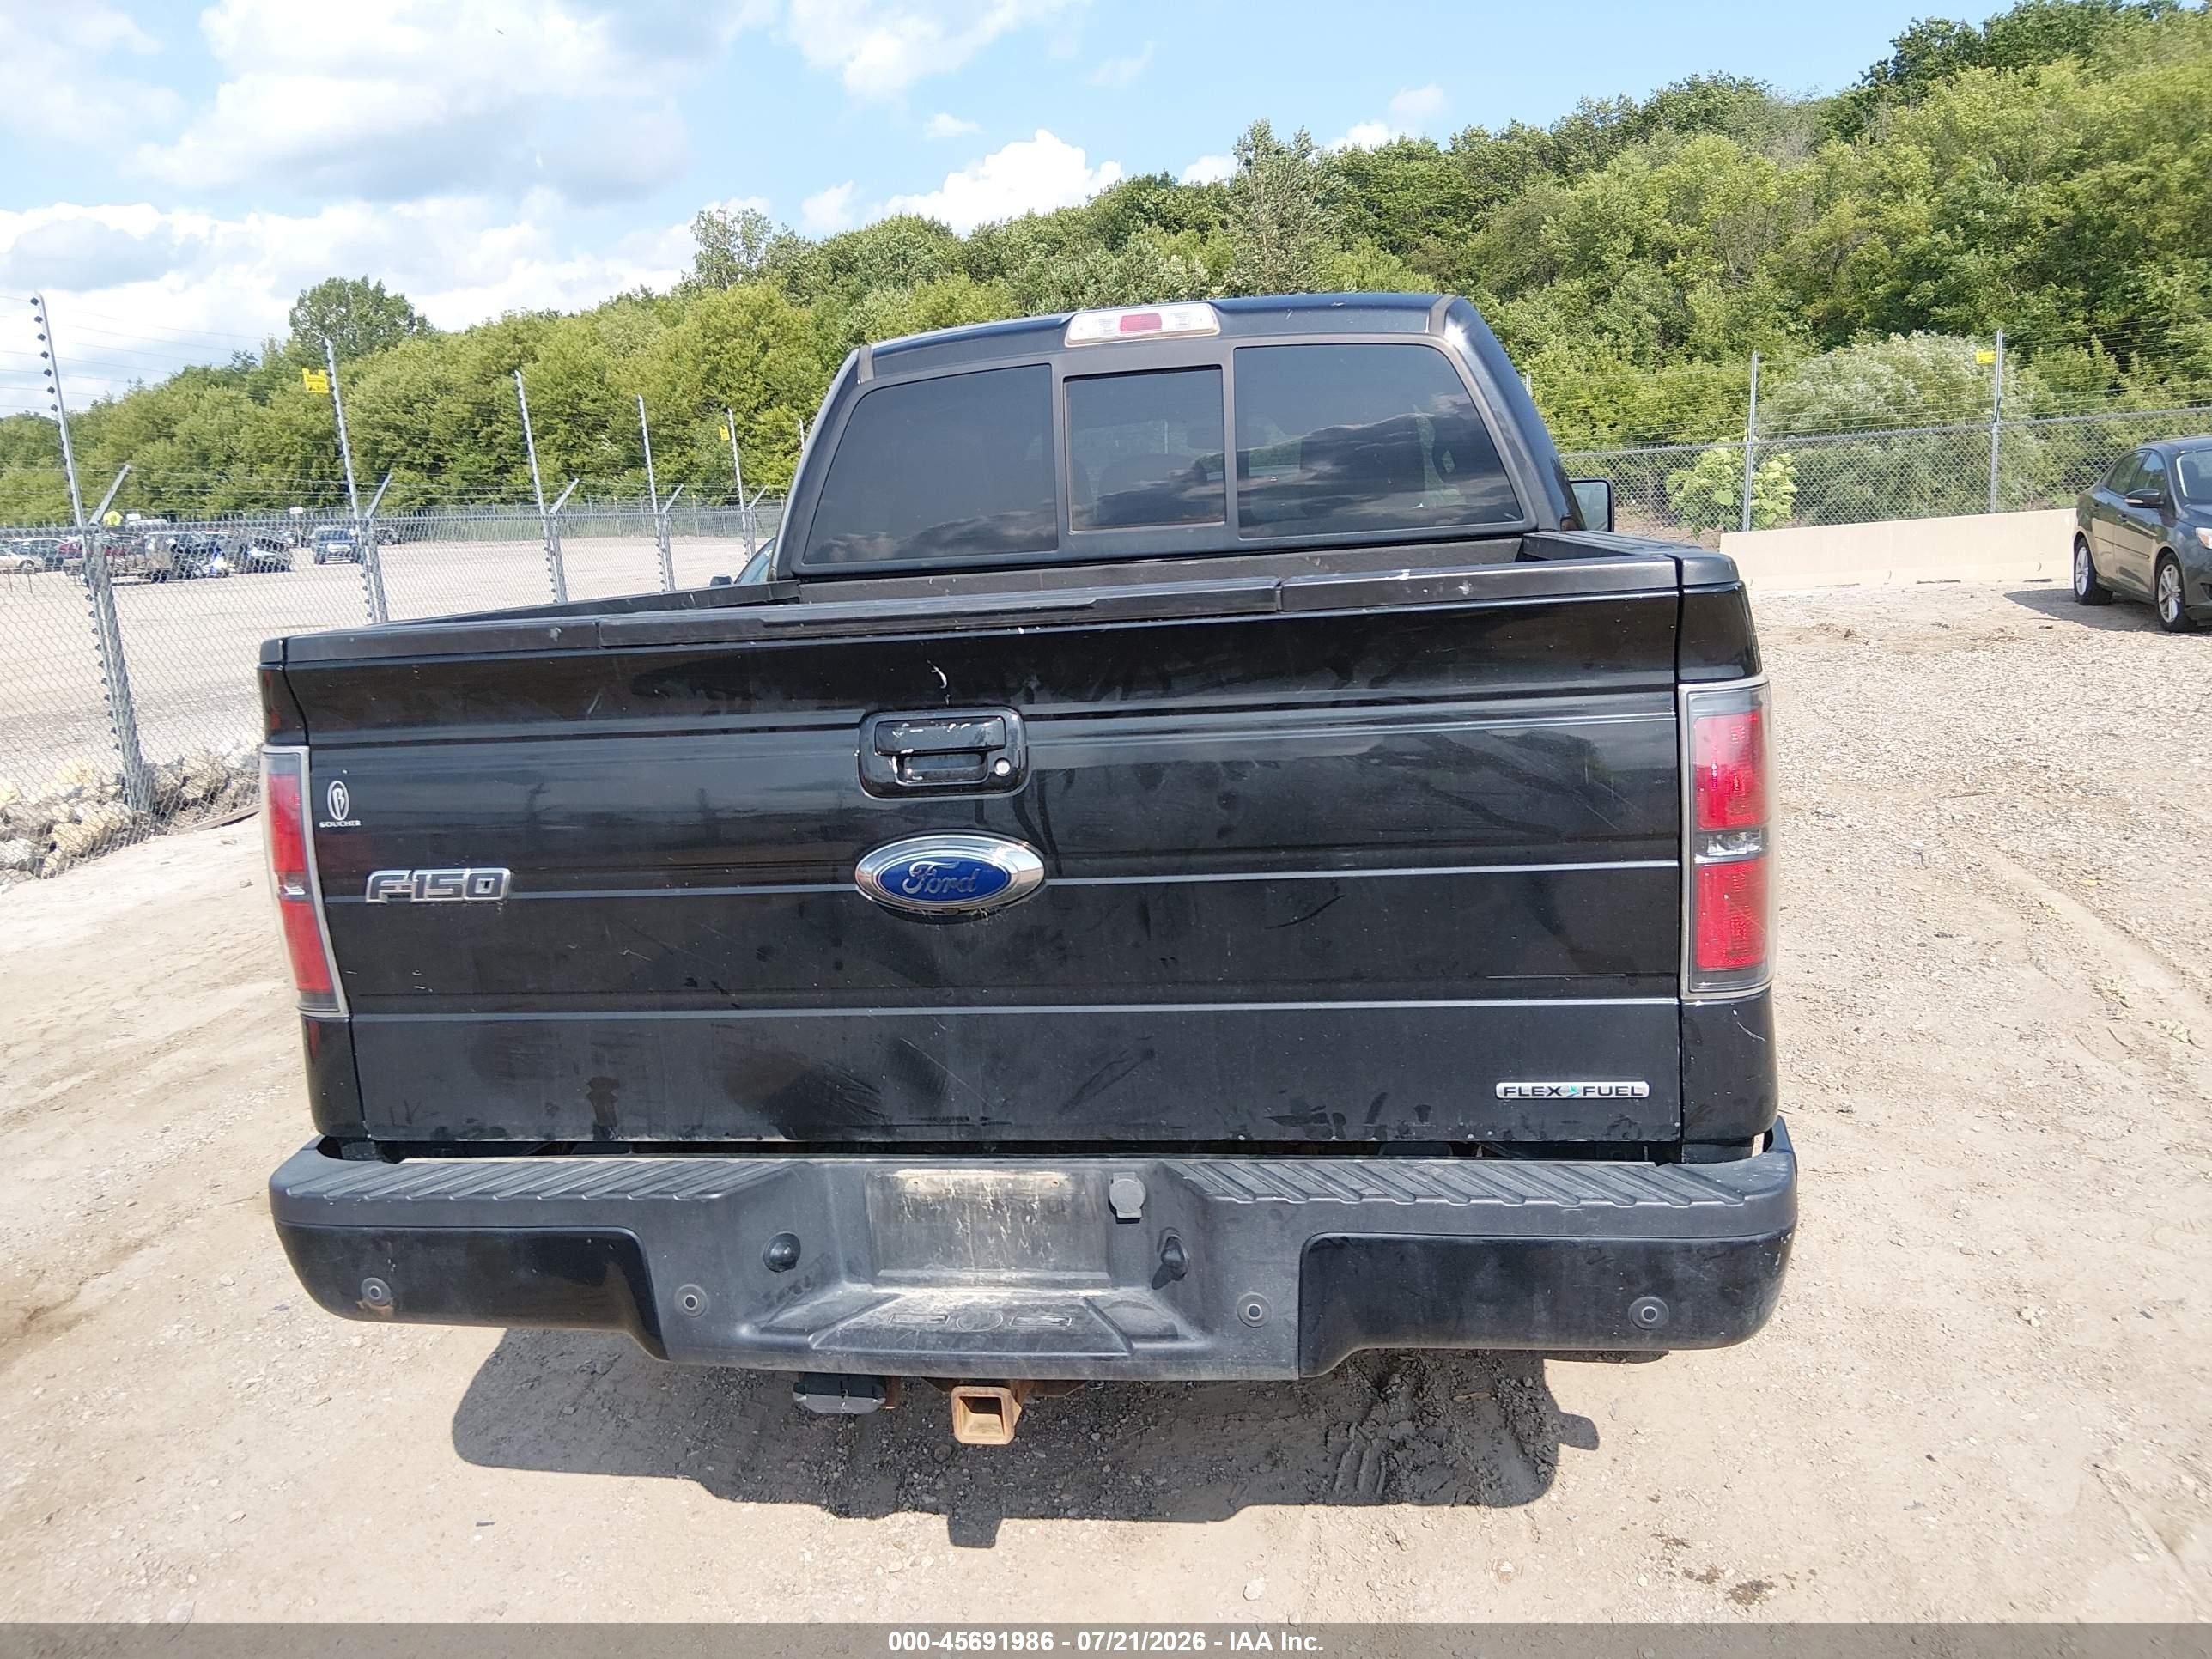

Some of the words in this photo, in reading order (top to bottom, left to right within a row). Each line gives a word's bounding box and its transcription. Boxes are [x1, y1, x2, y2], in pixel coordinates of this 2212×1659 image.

[902, 860, 981, 895] Ford
[1504, 1085, 1563, 1097] FLEX
[1583, 1085, 1644, 1097] FUEL
